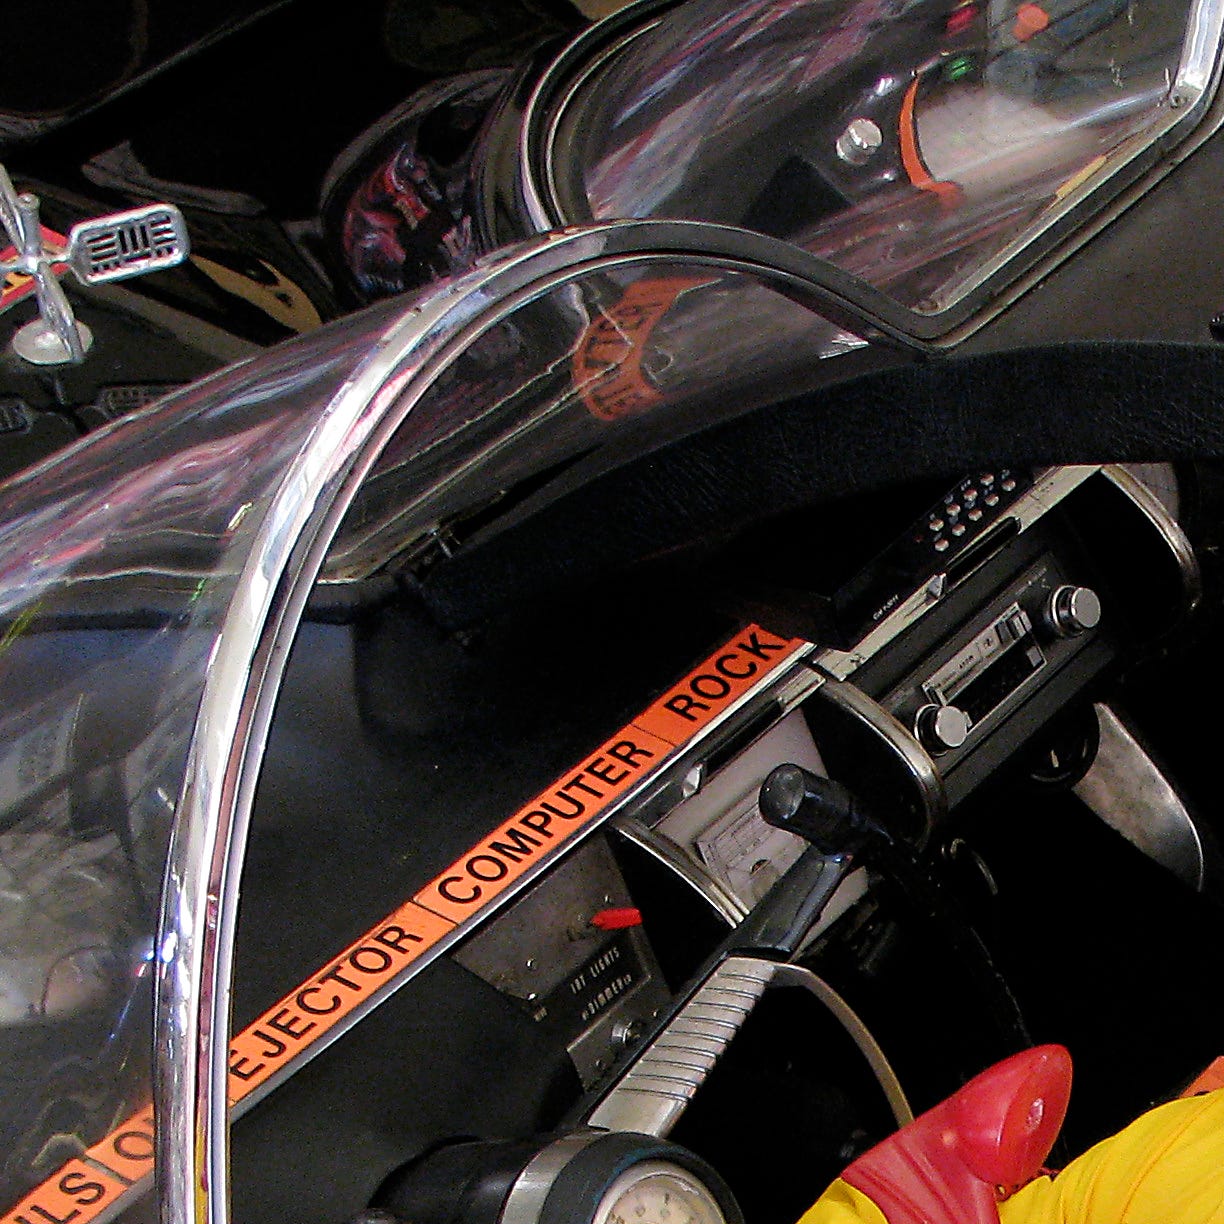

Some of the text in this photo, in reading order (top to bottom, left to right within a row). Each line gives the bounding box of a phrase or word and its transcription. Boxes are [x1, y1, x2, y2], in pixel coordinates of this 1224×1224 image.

[229, 923, 424, 1081] EJECTOR
[436, 737, 655, 905] COMPUTER
[663, 631, 786, 722] ROCK
